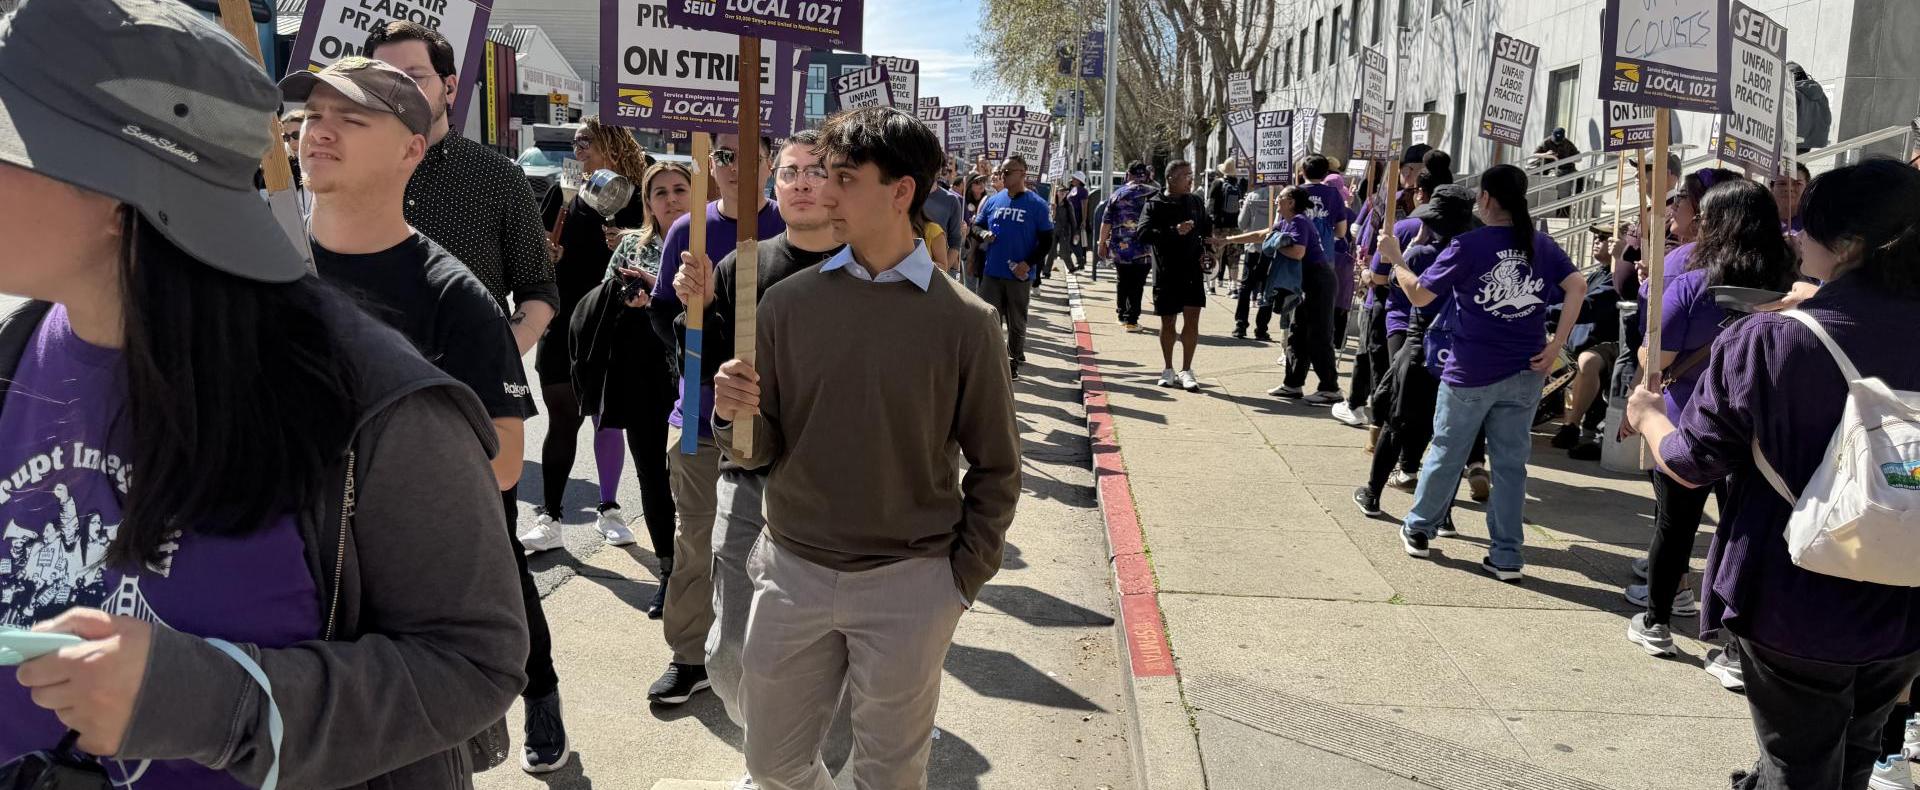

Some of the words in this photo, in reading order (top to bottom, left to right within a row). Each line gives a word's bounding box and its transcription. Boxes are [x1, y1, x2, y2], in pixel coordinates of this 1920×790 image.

[683, 0, 716, 16] SEIU
[798, 2, 842, 26] 1021
[1624, 10, 1711, 58] COURTS
[1734, 8, 1782, 53] SEIU
[1497, 38, 1535, 65] SEIU
[624, 46, 668, 76] ON
[676, 50, 770, 84] STRIE
[1366, 50, 1386, 72] SEIU
[1742, 50, 1773, 77] UNFAIR
[838, 64, 882, 94] SEIU
[1228, 71, 1250, 80] SEIU
[1502, 64, 1524, 80] UNFAIR
[1500, 76, 1522, 92] LABOR
[1613, 81, 1639, 92] SEIU
[1645, 75, 1685, 94] LOCAL
[1689, 82, 1716, 97] 1021
[1742, 68, 1771, 94] LABOR
[685, 93, 716, 101] Employees
[849, 88, 878, 103] UNFAIR
[918, 98, 936, 107] EIU
[1494, 88, 1524, 104] PRACTICE
[1735, 84, 1774, 114] PRACTICE
[617, 106, 652, 118] SEIU
[663, 100, 726, 118] LOCAL
[918, 109, 944, 120] EIU
[949, 106, 967, 115] EIU
[986, 106, 1020, 118] SEIU
[1025, 112, 1050, 122] SEIU
[1227, 108, 1254, 125] SEIU
[1487, 105, 1499, 118] ON
[1500, 108, 1523, 124] STRIKE
[1613, 105, 1629, 121] ON
[1257, 111, 1289, 128] SEIU
[1729, 110, 1744, 132] ON
[1746, 117, 1774, 144] STRIKE
[1012, 122, 1047, 137] SEIU
[1493, 127, 1510, 137] LOCAL
[1628, 131, 1650, 140] LOCAL
[1016, 138, 1038, 146] UNFAIR
[1016, 145, 1036, 153] LABOR
[1258, 162, 1265, 170] ON
[1267, 161, 1287, 170] STRIKE
[1739, 147, 1759, 162] LOCAL
[1760, 156, 1772, 168] 1021
[994, 208, 1026, 222] IFPTE
[1474, 275, 1544, 304] Strike
[0, 446, 64, 504] rupt
